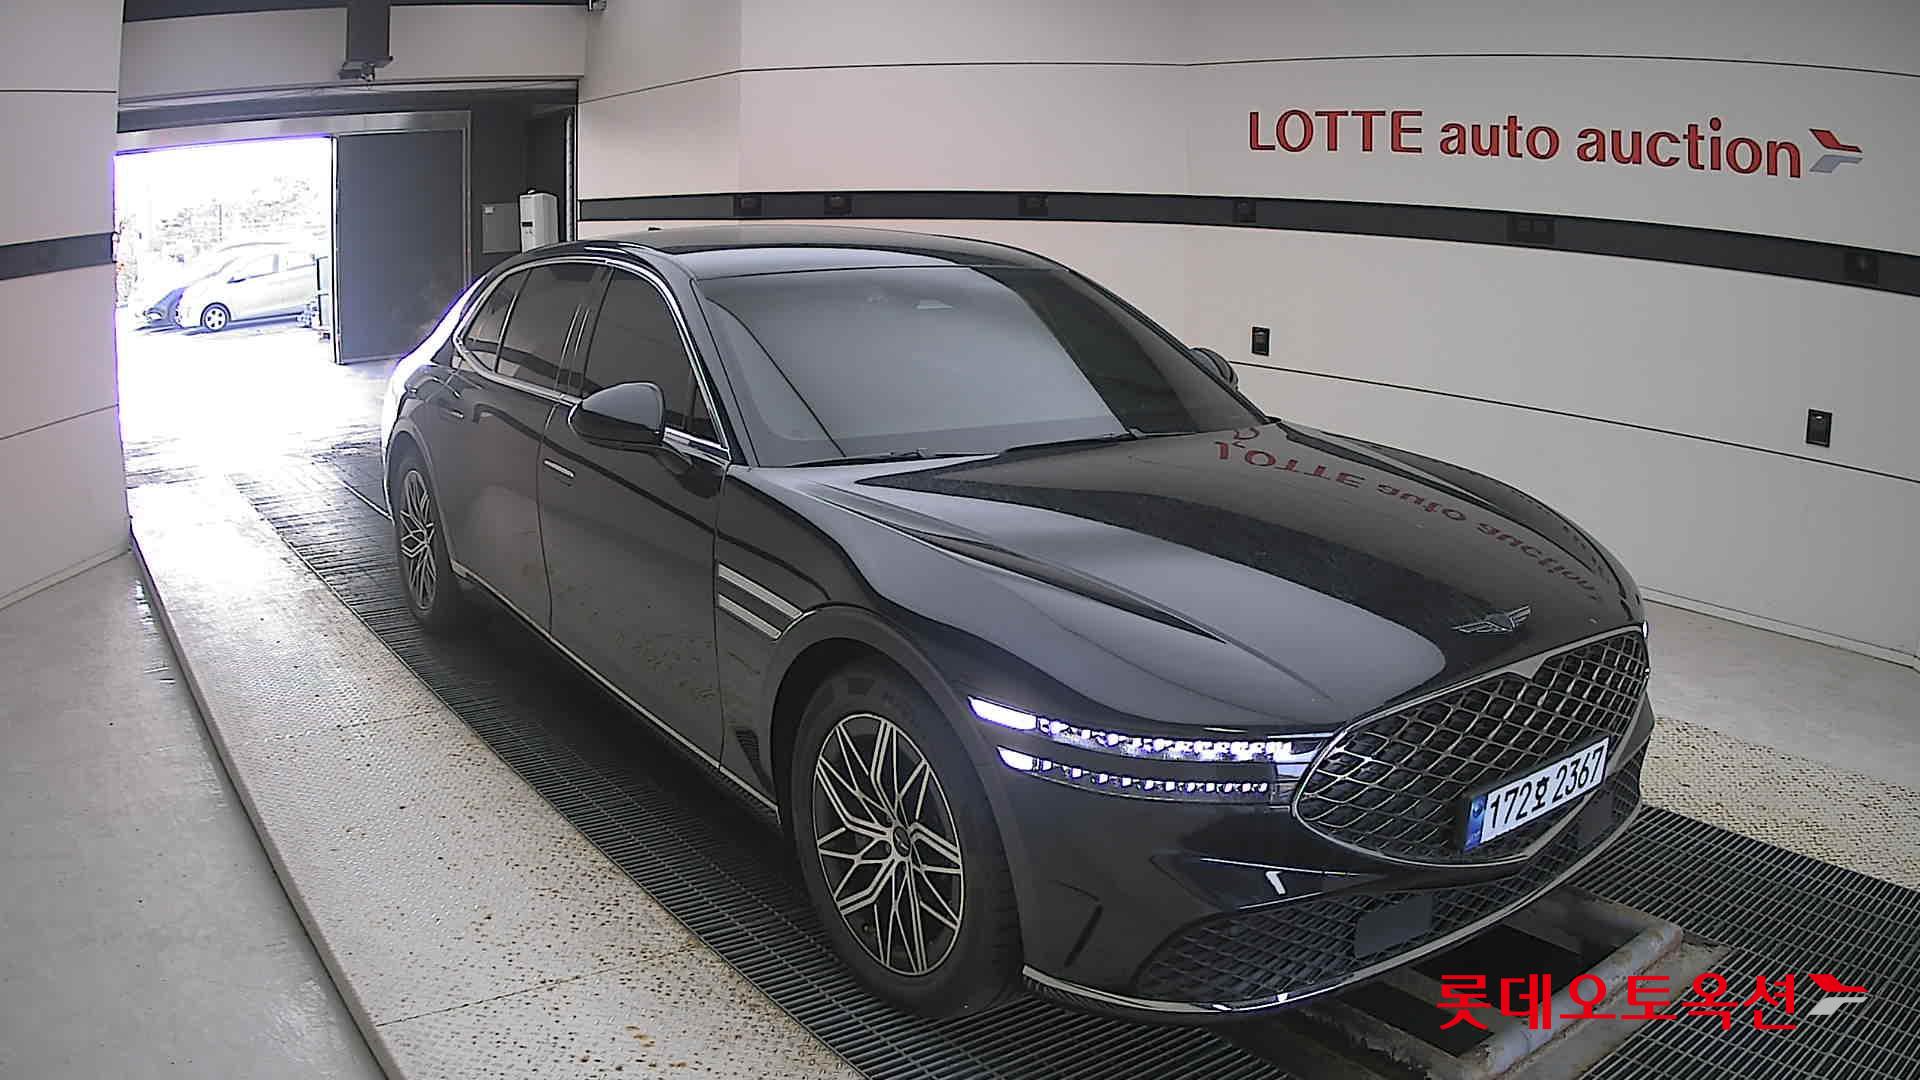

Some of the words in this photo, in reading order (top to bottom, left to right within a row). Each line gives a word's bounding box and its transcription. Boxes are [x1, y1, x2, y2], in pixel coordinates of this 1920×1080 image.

[1248, 110, 1424, 154] LOTTE
[1439, 115, 1560, 161] auto
[1576, 117, 1802, 179] auction
[1552, 745, 1605, 803] 2367
